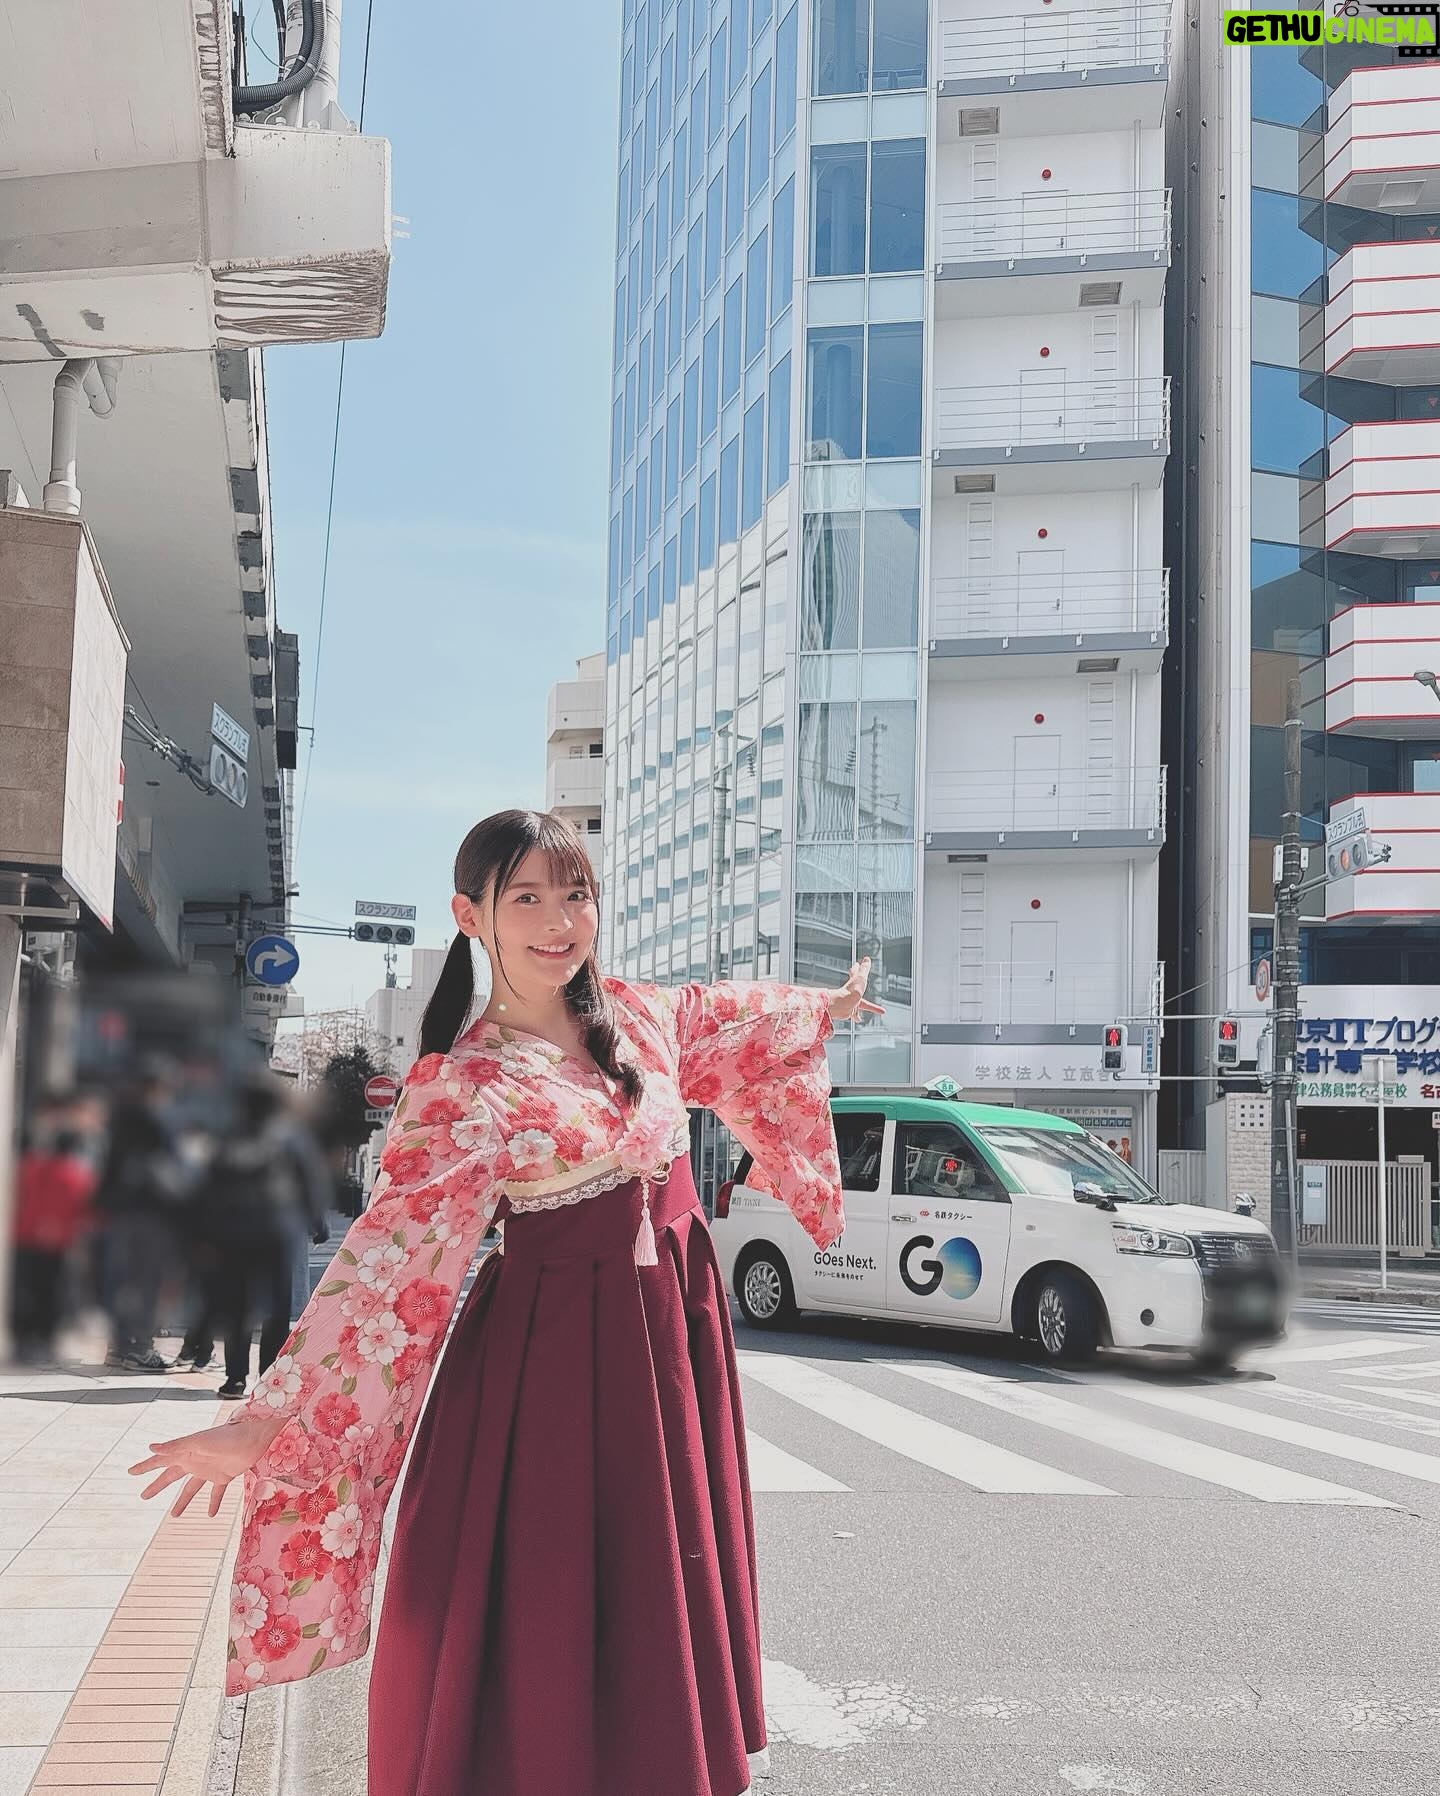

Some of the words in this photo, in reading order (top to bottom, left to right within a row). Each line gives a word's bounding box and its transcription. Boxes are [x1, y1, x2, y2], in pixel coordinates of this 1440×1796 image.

[214, 711, 248, 756] スクランブル式
[358, 903, 414, 918] スクランブル式
[1296, 1016, 1440, 1044] 京ITプログ
[975, 1065, 1052, 1081] 学校法人
[1296, 1048, 1440, 1076] 計専学校
[934, 1210, 973, 1221] 名鉄タクシー
[814, 1251, 844, 1267] GOes
[846, 1254, 877, 1270] Next.
[899, 1235, 982, 1299] GO
